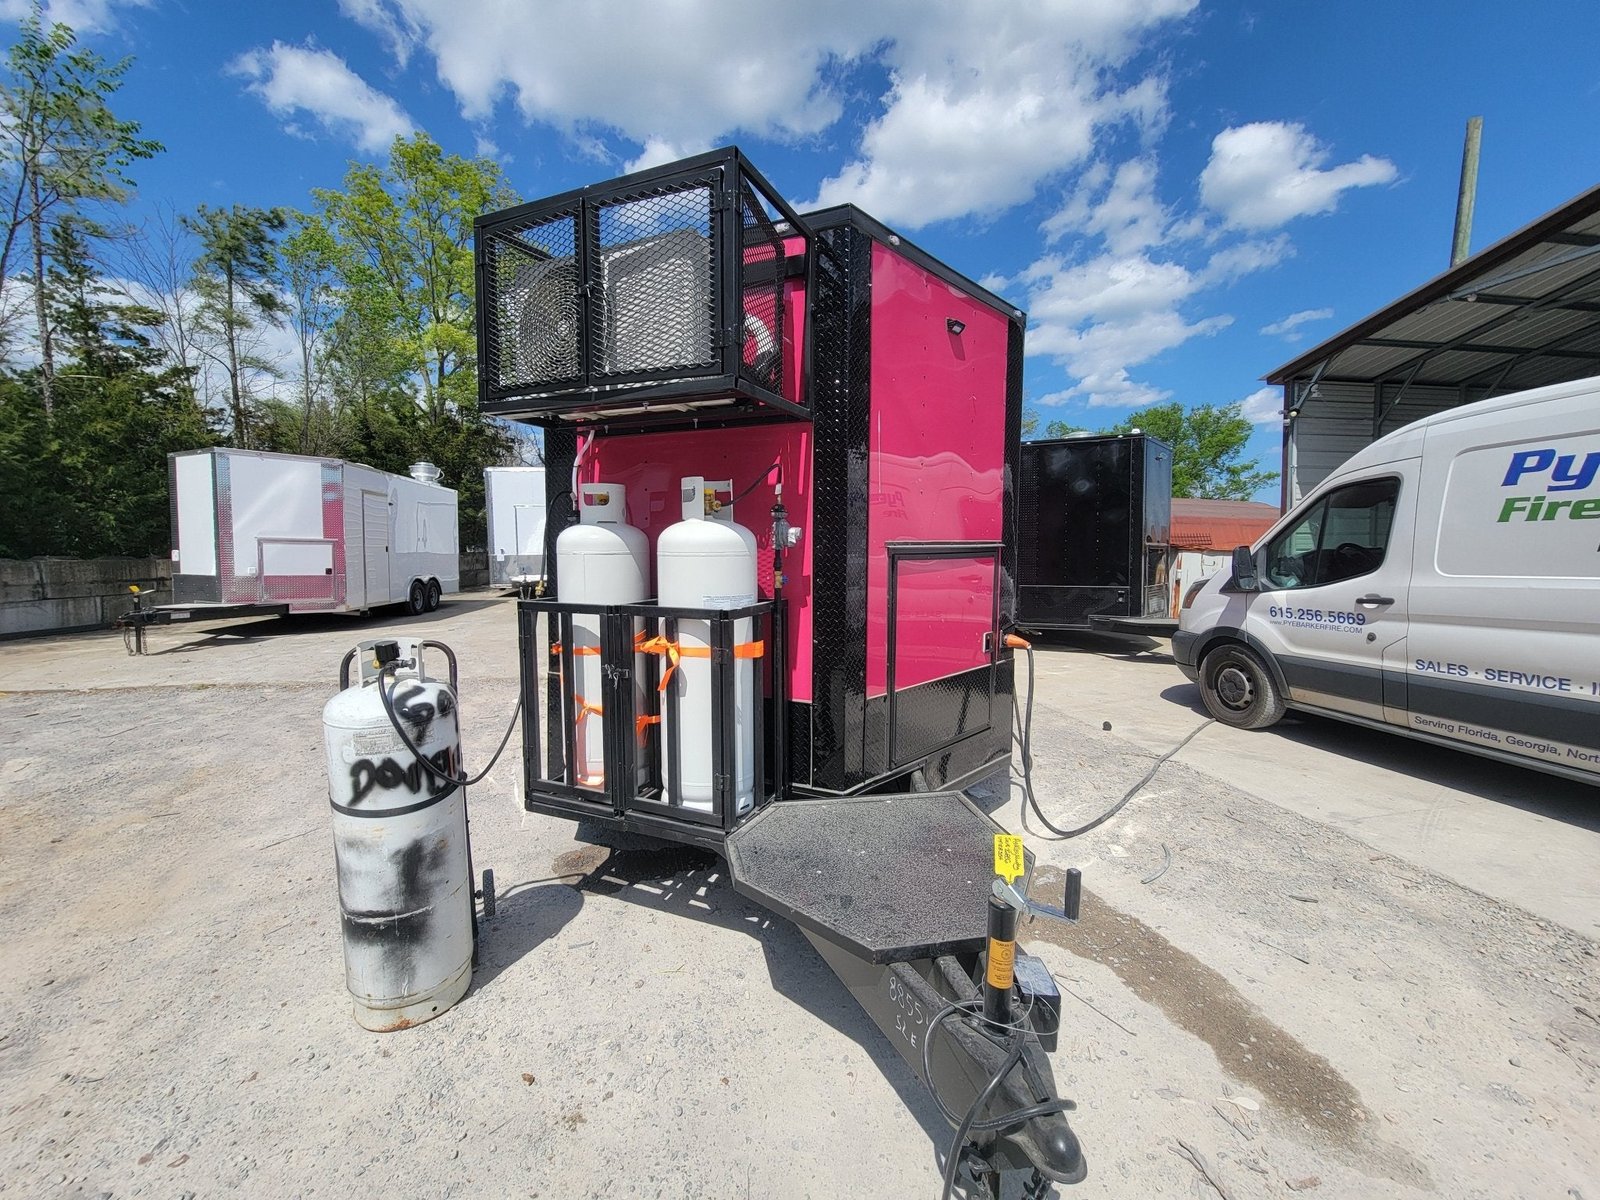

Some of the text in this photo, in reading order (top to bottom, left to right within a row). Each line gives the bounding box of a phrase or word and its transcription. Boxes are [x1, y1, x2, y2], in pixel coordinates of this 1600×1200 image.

[1501, 449, 1600, 492] Py
[1497, 496, 1600, 522] Fire
[1269, 606, 1366, 626] 615.256.5669
[1415, 659, 1469, 677] SALES
[1484, 668, 1571, 692] SERVICE
[1414, 715, 1455, 733] Serving
[1457, 725, 1502, 744] Florida,
[1505, 735, 1561, 756] Georgia,
